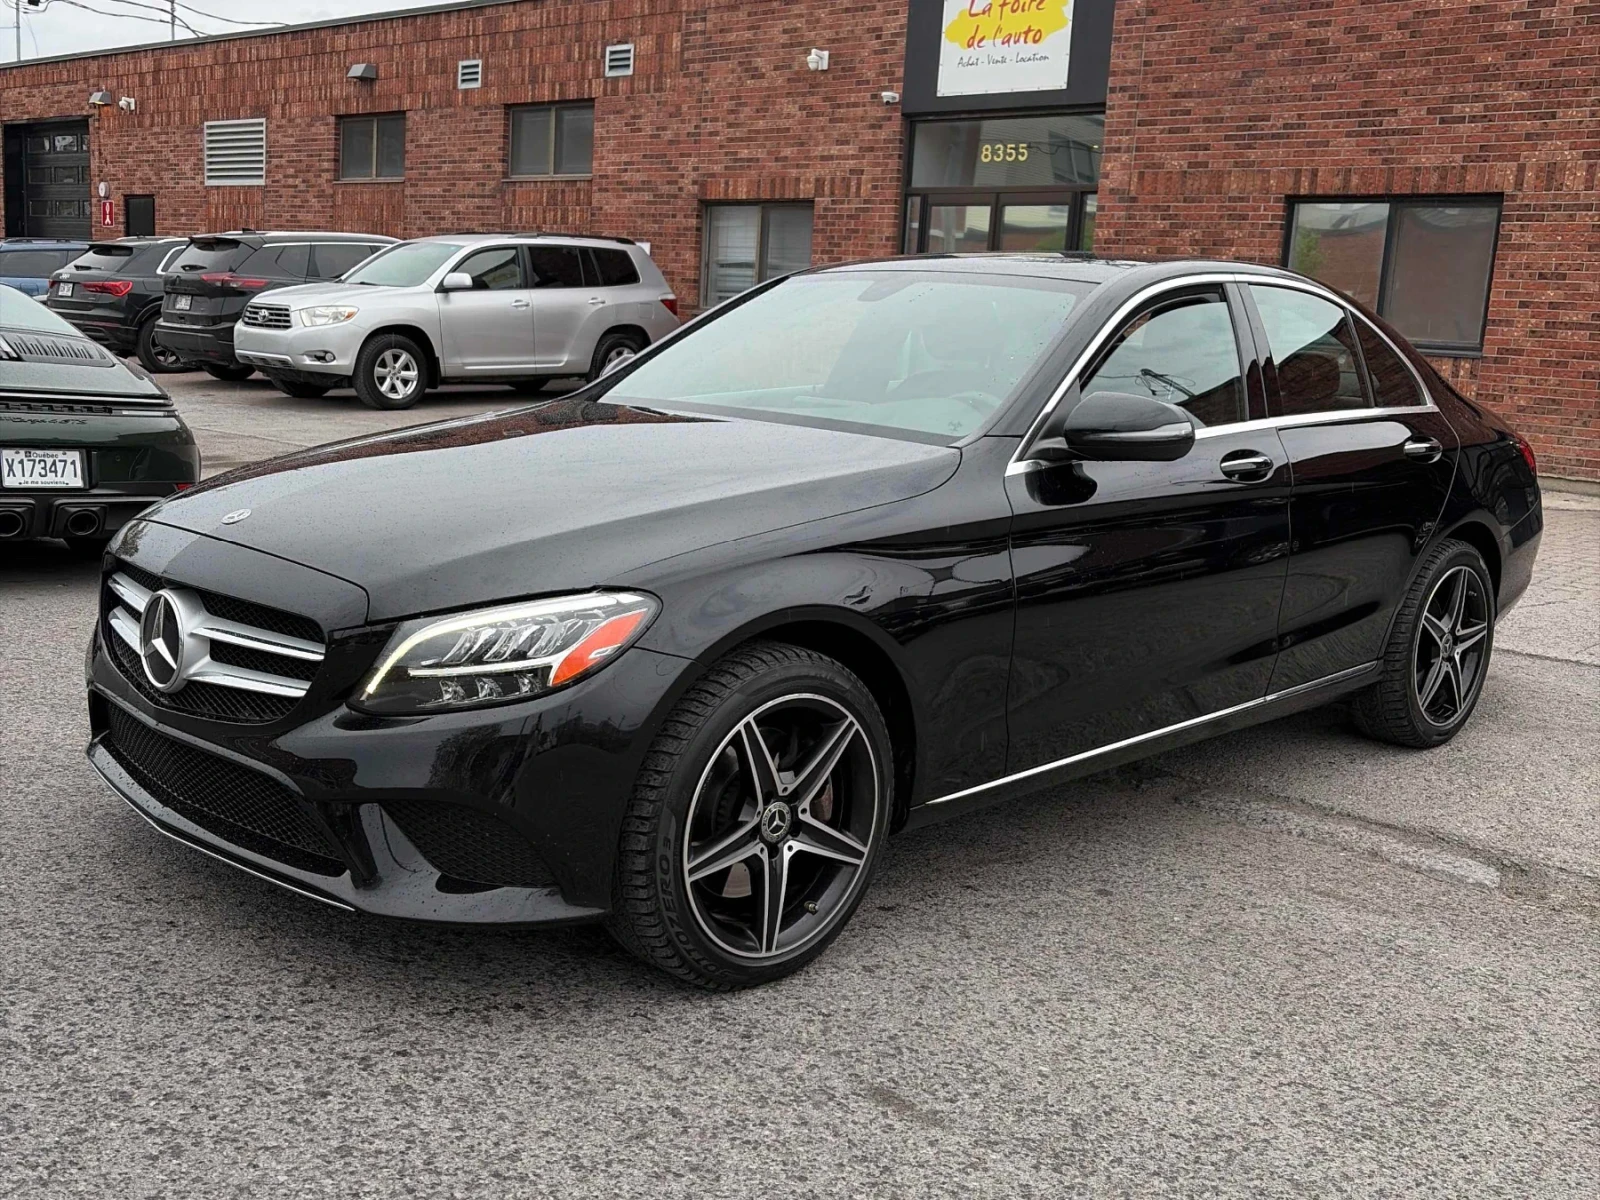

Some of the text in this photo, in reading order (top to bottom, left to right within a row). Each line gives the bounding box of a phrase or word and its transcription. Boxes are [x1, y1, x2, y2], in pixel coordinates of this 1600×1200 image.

[968, 0, 1046, 21] La foire
[966, 24, 1043, 50] de l'auto
[957, 55, 979, 68] Achat
[987, 53, 1007, 65] Vente
[1015, 52, 1050, 64] Location
[980, 143, 1028, 163] 8355
[32, 451, 59, 459] Québec
[5, 458, 78, 479] X173471
